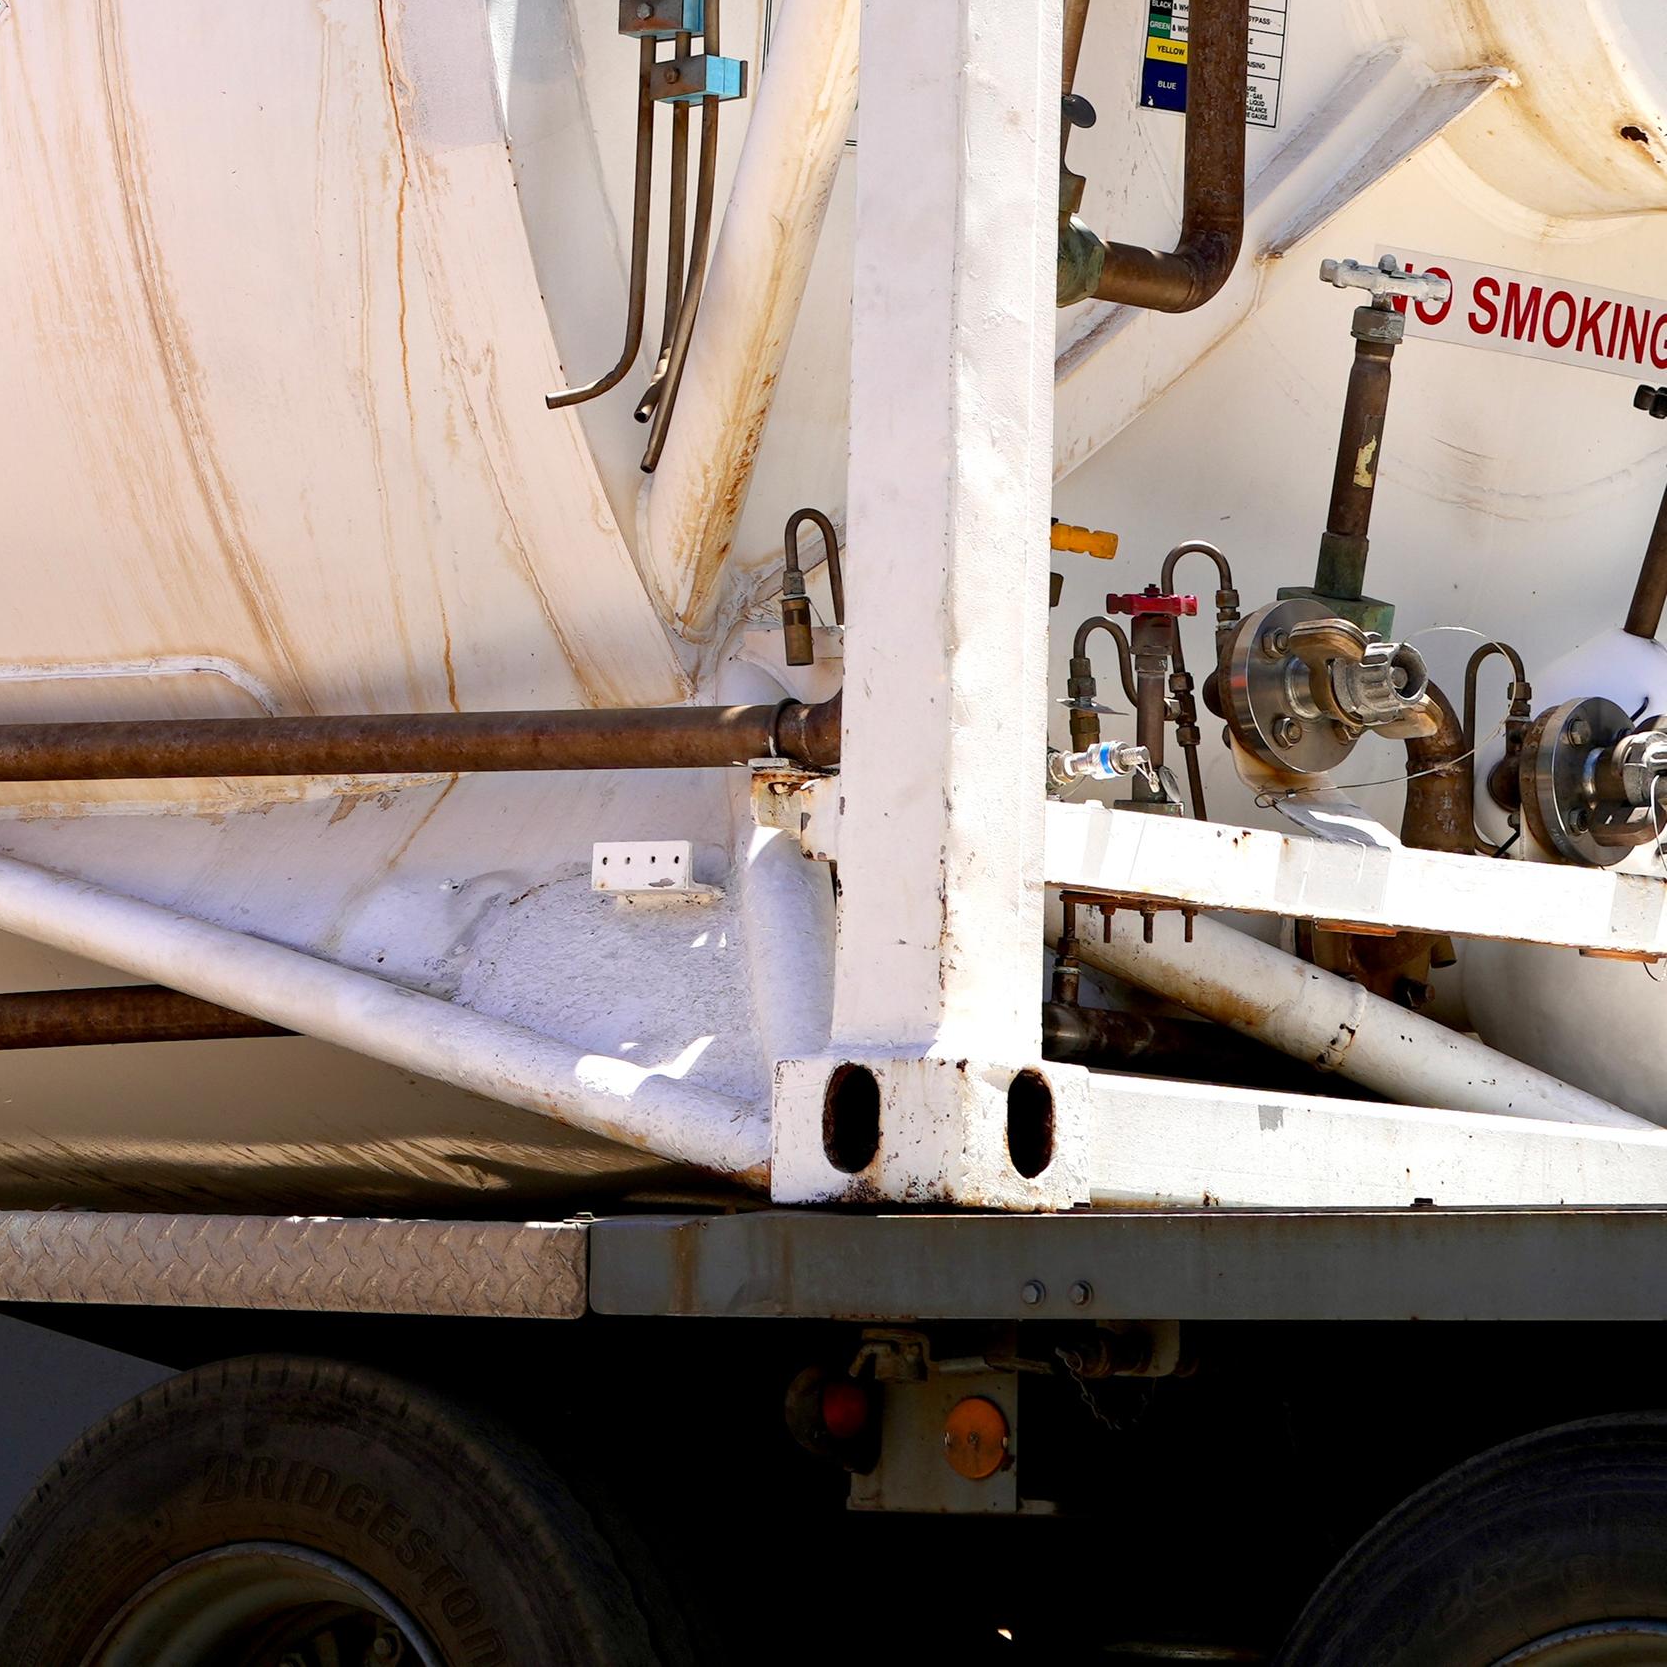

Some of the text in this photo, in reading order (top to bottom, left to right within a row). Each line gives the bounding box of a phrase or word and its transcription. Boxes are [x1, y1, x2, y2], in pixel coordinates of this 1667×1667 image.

[1152, 0, 1172, 9] BLACK
[1150, 21, 1170, 30] GREEN
[1157, 45, 1185, 55] YELLOW
[1158, 80, 1177, 90] BLUE
